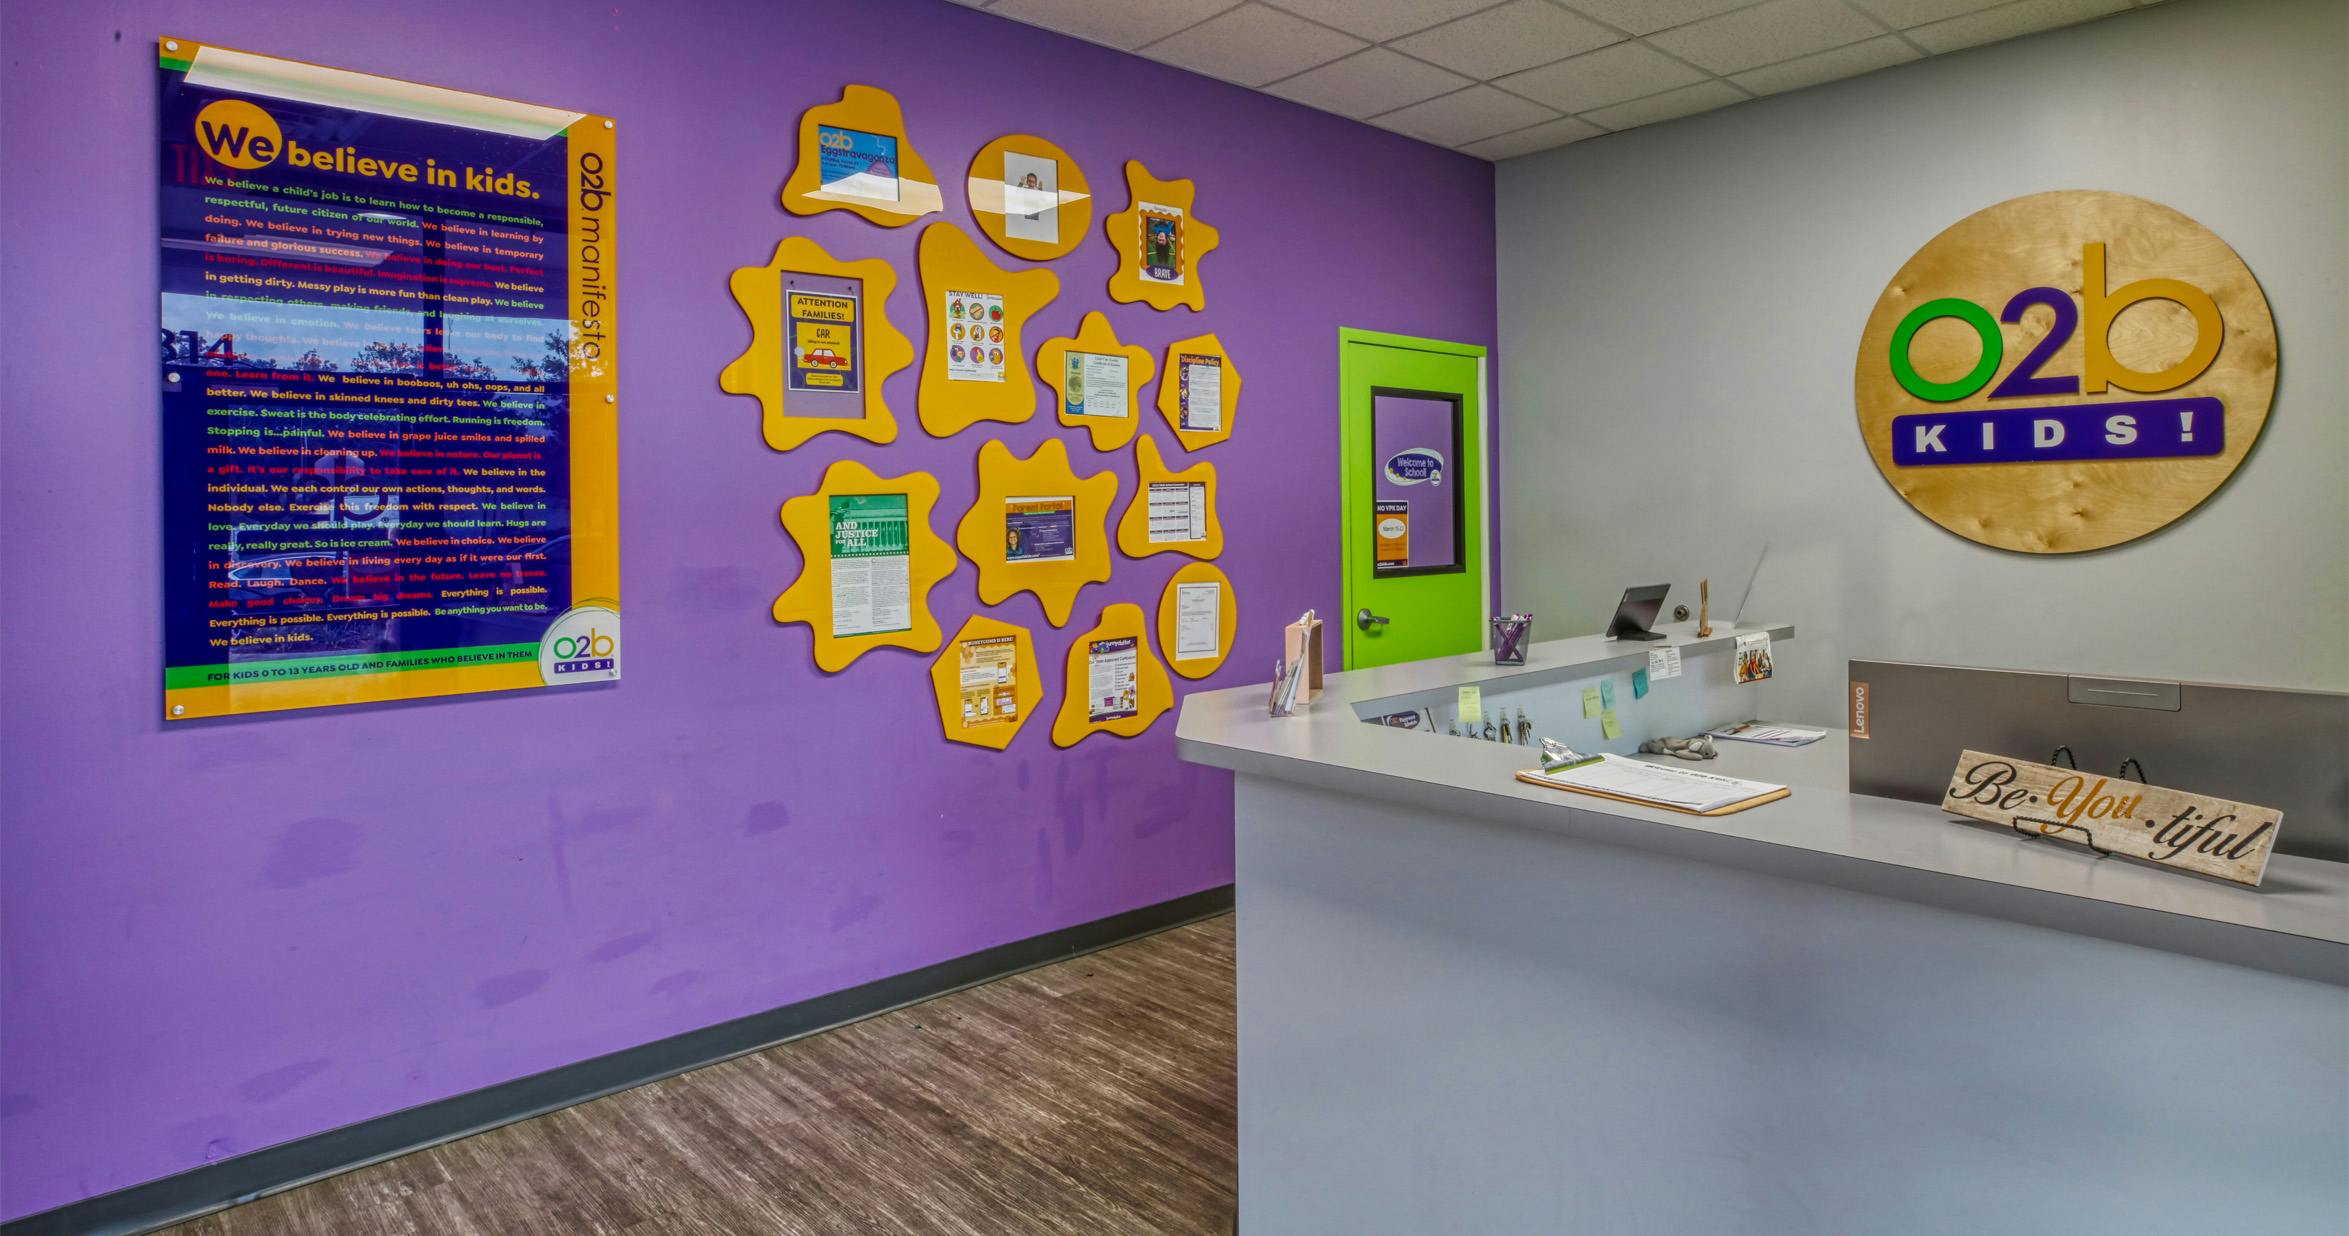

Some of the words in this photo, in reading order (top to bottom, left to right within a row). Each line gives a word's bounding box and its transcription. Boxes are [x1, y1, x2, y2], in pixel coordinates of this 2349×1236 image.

[820, 130, 853, 150] o2b
[201, 121, 274, 160] We
[288, 141, 418, 178] believe
[426, 159, 456, 188] in
[466, 166, 540, 199] kids.
[205, 175, 223, 185] We
[227, 177, 268, 190] believe
[283, 186, 317, 197] child's
[321, 190, 338, 200] job
[342, 193, 351, 201] is
[355, 195, 365, 203] to
[369, 196, 395, 207] learn
[399, 200, 419, 210] how
[423, 204, 433, 212] to
[437, 205, 475, 217] become
[487, 213, 543, 227] responsible,
[205, 214, 241, 228] doing.
[246, 219, 263, 228] We
[268, 221, 308, 233] believe
[312, 226, 322, 234] in
[326, 228, 358, 241] trying
[387, 235, 422, 247] things.
[426, 240, 440, 248] We
[445, 241, 479, 252] believe
[495, 248, 543, 262] temporary
[1154, 268, 1170, 279] BRAVE
[205, 272, 216, 280] in
[219, 275, 262, 287] getting
[265, 277, 294, 290] dirty.
[297, 281, 330, 293] Messy
[333, 284, 354, 295] play
[358, 286, 366, 294] is
[369, 288, 395, 296] more
[398, 289, 415, 298] fun
[418, 291, 440, 300] than
[443, 294, 468, 303] clean
[471, 296, 492, 307] play.
[511, 300, 544, 309] believe
[582, 217, 606, 360] manifesto
[798, 297, 848, 308] ATTENTION
[802, 310, 845, 320] FAMILIES!
[1889, 242, 2225, 401] o2b
[816, 328, 831, 338] CAR
[1206, 358, 1219, 367] Policy
[318, 374, 335, 382] We
[343, 375, 379, 384] believe
[384, 377, 393, 385] in
[397, 378, 443, 388] booboos,
[462, 382, 481, 390] ohs,
[485, 384, 510, 393] oops,
[207, 387, 246, 397] better.
[272, 390, 311, 399] believe
[315, 392, 325, 400] in
[329, 393, 370, 402] skinned
[374, 395, 404, 403] knees
[429, 397, 453, 408] dirty
[501, 400, 532, 408] believe
[207, 426, 260, 437] Stopping
[348, 430, 385, 438] believe
[402, 433, 430, 442] grape
[434, 432, 458, 442] juice
[515, 435, 544, 444] spilled
[1397, 457, 1426, 468] Welcome
[1427, 459, 1434, 468] to
[1405, 468, 1427, 478] School!
[208, 483, 267, 491] individual.
[320, 484, 358, 492] control
[406, 485, 444, 493] actions,
[448, 485, 493, 494] thoughts,
[836, 522, 857, 530] AND
[836, 530, 878, 538] JUSTICE
[847, 538, 866, 546] ALL
[209, 617, 265, 628] Everything
[268, 616, 277, 624] is
[280, 614, 324, 626] possible.
[327, 611, 377, 622] Everything
[391, 609, 430, 620] possible.
[447, 606, 485, 616] anything
[486, 606, 501, 615] you
[503, 604, 523, 612] want
[210, 638, 228, 646] We
[230, 636, 272, 645] believe
[275, 634, 284, 642] in
[287, 633, 312, 641] kids.
[554, 628, 614, 659] o2b
[208, 672, 229, 680] FOR
[233, 670, 258, 679] KIDS
[272, 668, 286, 676] TO
[302, 664, 333, 673] YEARS
[336, 663, 358, 671] OLD
[362, 661, 383, 669] AND
[386, 658, 429, 667] FAMILIES
[432, 656, 454, 664] WHO
[458, 653, 495, 662] BELIEVE
[507, 650, 532, 658] THEM
[1852, 687, 1867, 735] Lenovo
